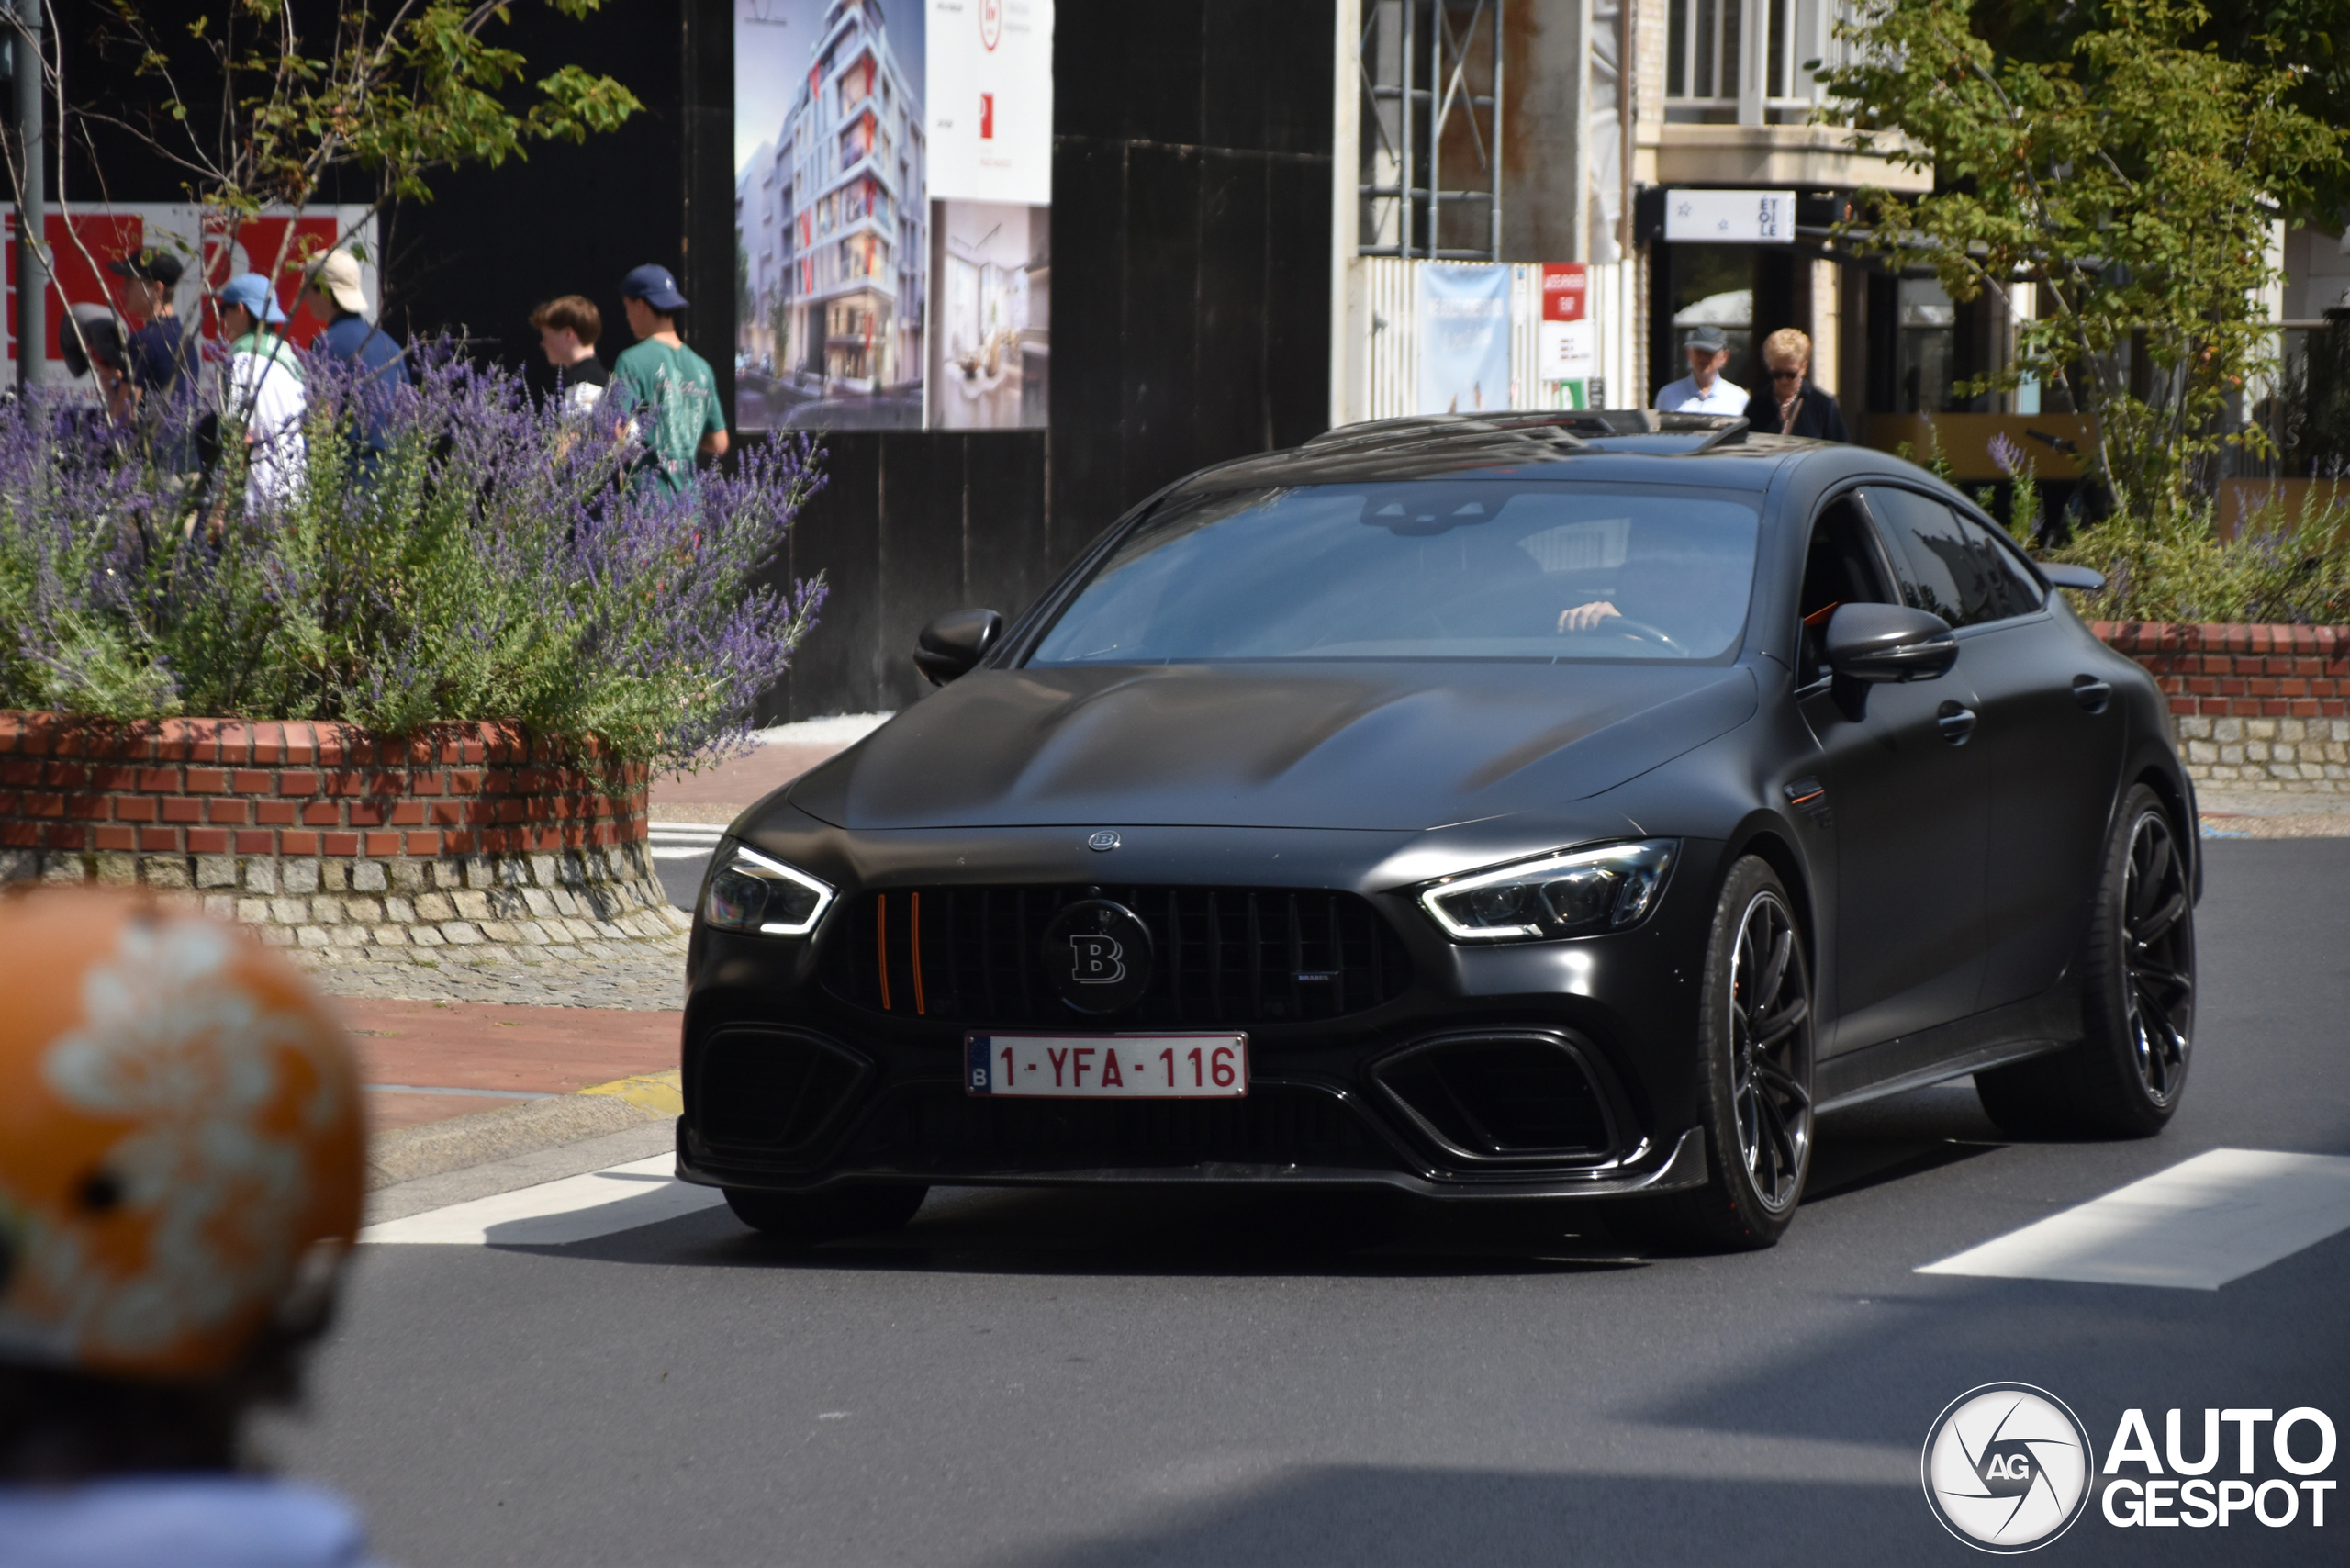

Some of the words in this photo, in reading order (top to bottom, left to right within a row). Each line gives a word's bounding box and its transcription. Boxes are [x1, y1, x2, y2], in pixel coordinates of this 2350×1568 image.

[1093, 834, 1114, 846] B
[1070, 935, 1125, 984] B
[973, 1068, 987, 1086] B
[1000, 1047, 1235, 1087] 1-YFA-116
